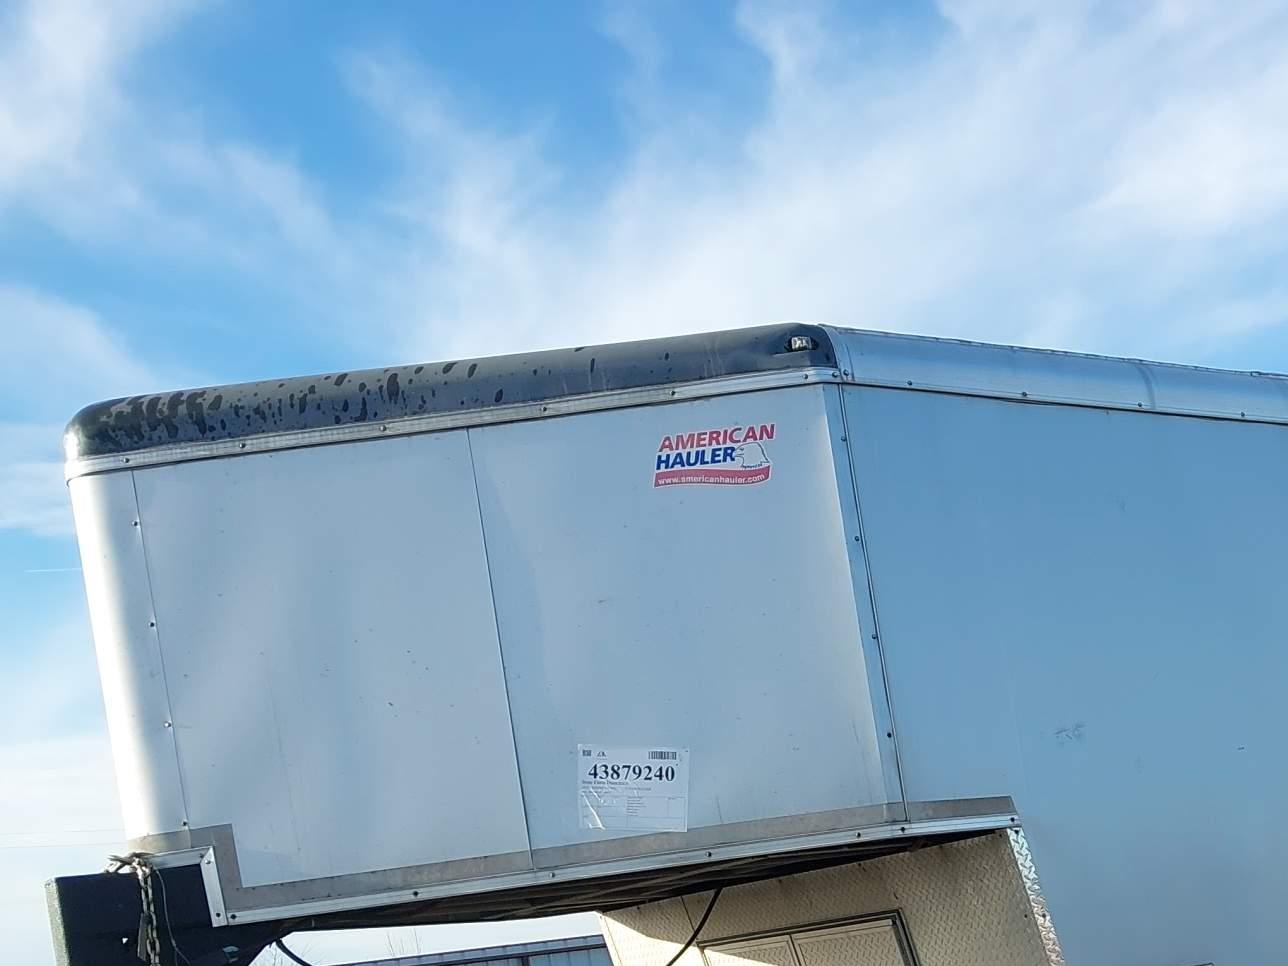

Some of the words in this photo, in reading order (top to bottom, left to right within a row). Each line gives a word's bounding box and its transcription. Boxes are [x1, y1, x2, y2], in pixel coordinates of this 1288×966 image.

[658, 423, 775, 452] AMERICAN
[655, 446, 736, 470] HAULER
[658, 474, 765, 485] www.americanhauler.com
[588, 763, 675, 782] 43879240
